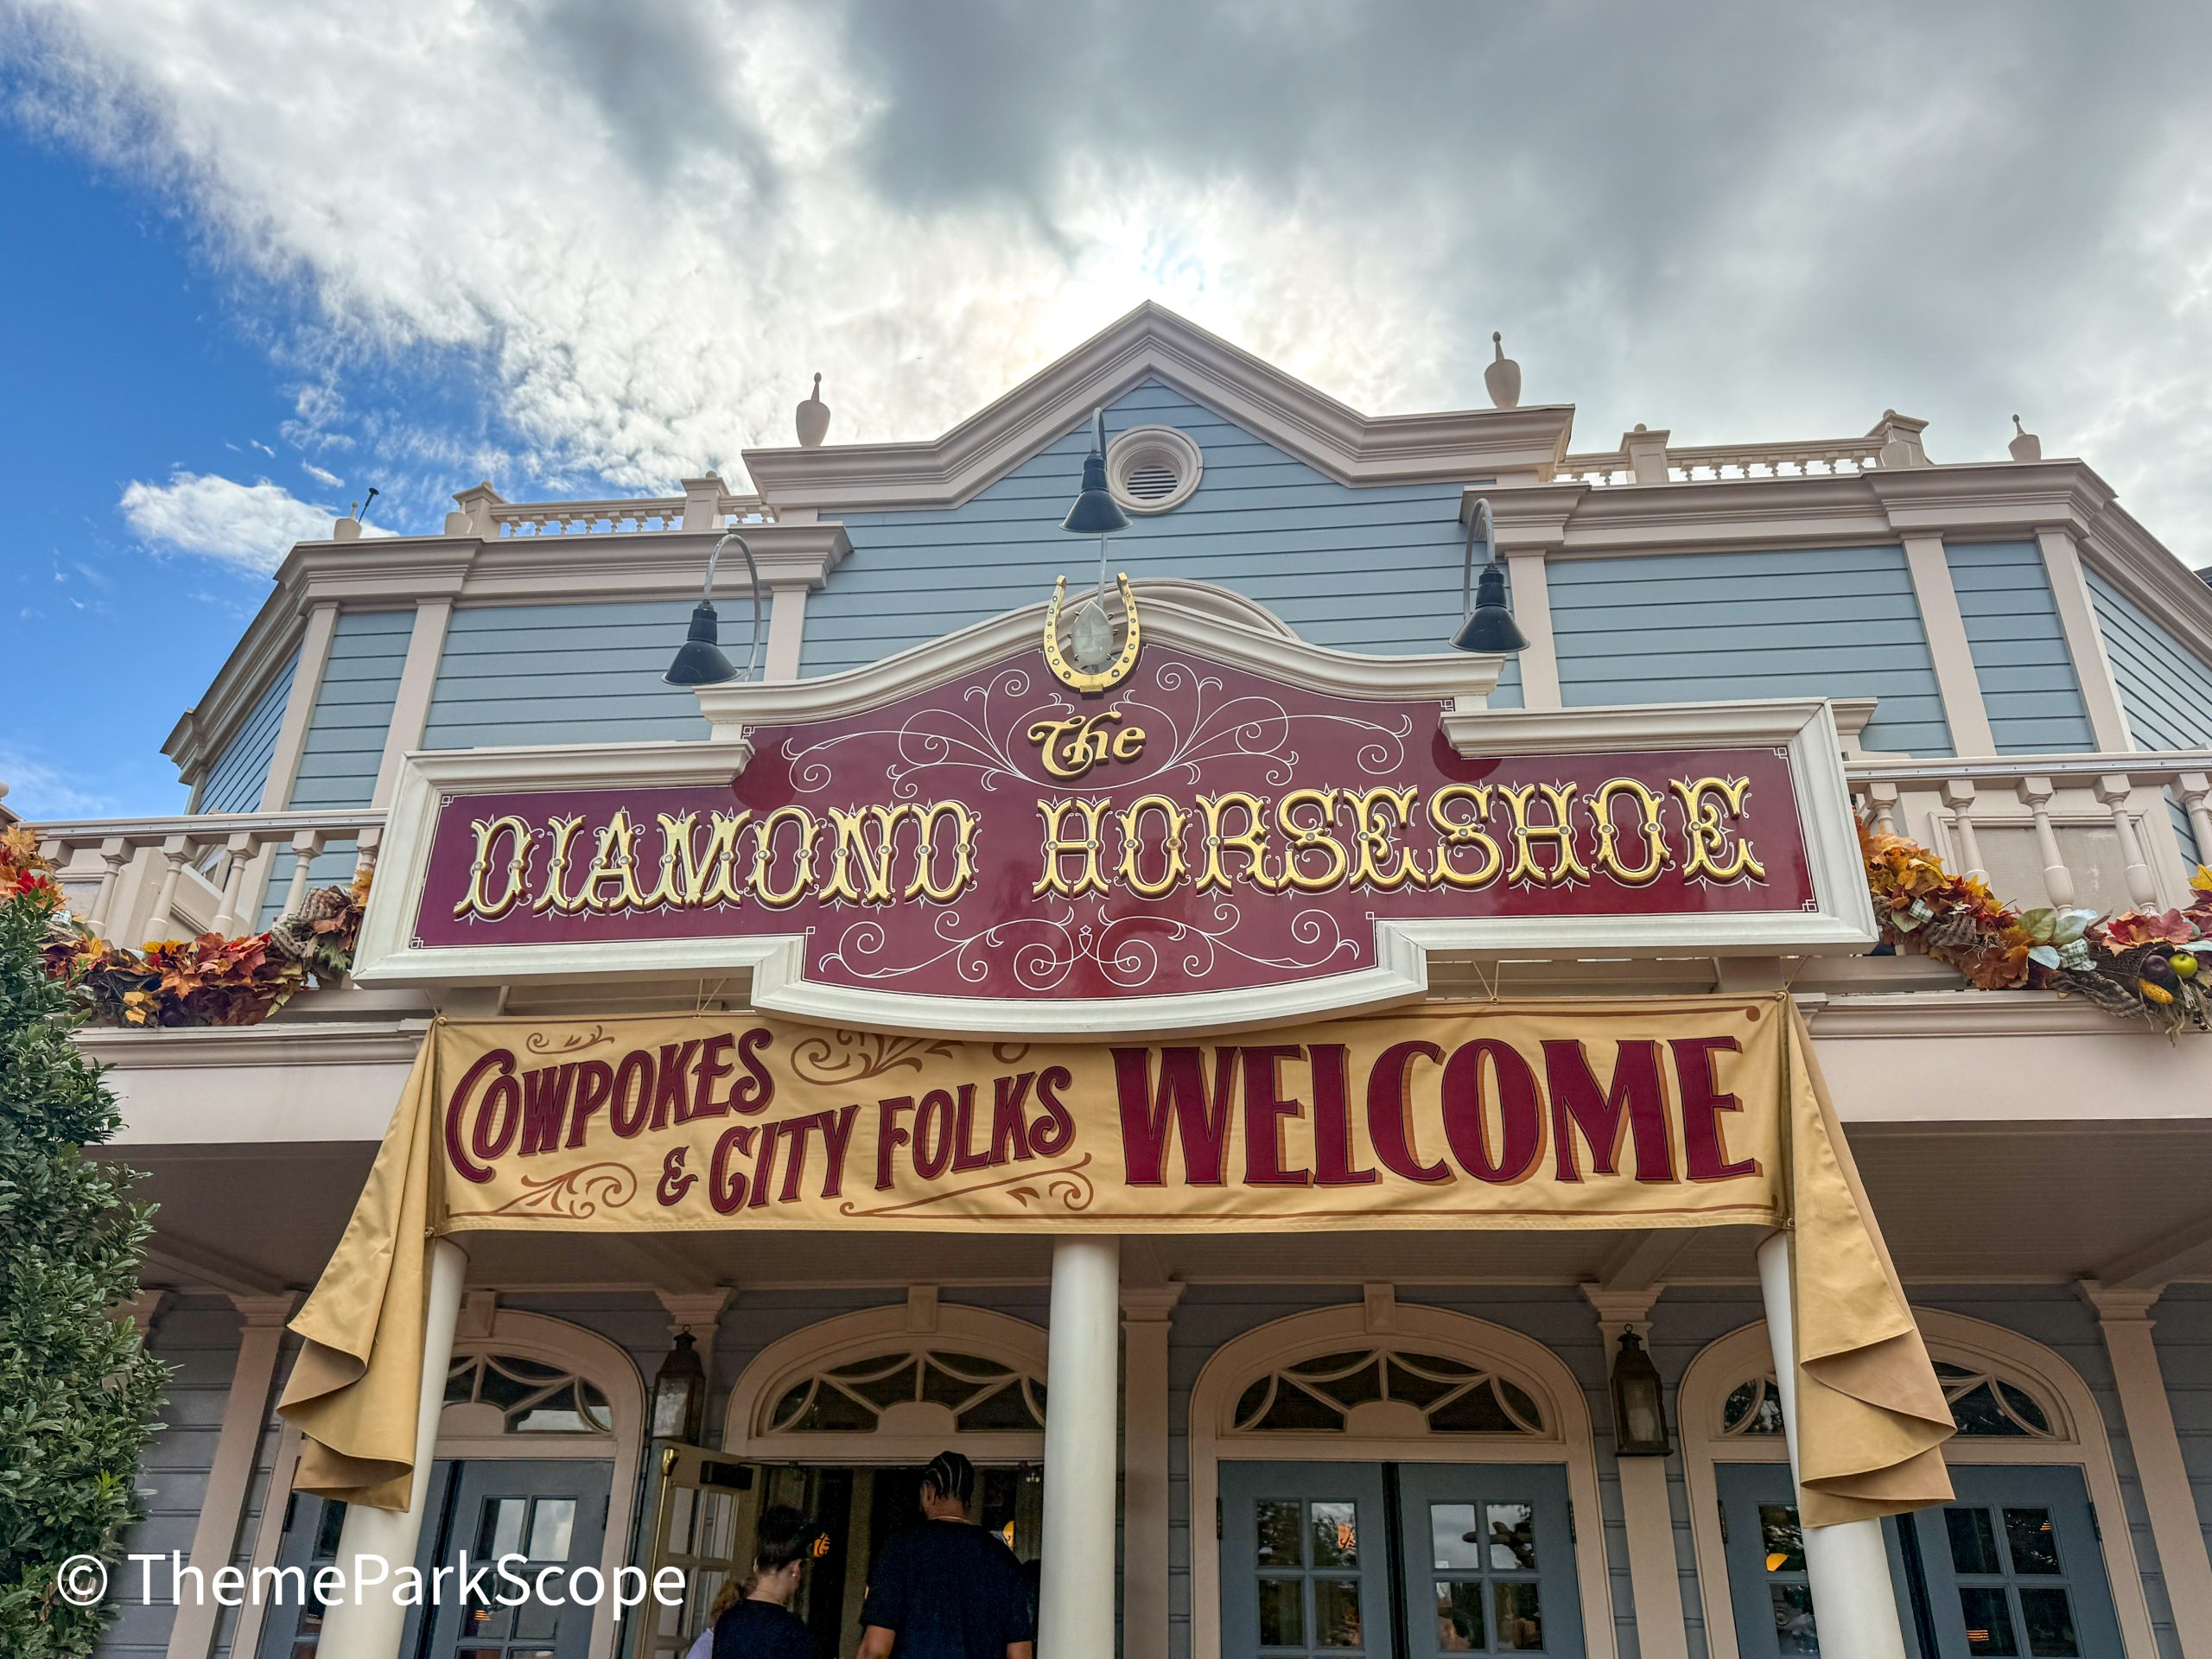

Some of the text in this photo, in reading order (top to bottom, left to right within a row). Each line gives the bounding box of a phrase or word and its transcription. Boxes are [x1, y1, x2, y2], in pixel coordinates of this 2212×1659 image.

[1027, 710, 1146, 779] The
[453, 774, 1768, 921] DIAMOND HORSESHOE
[445, 1027, 775, 1184] COWPOKES
[656, 1065, 1075, 1214] & CITY FOLKS
[1109, 1035, 1764, 1188] WELCOME
